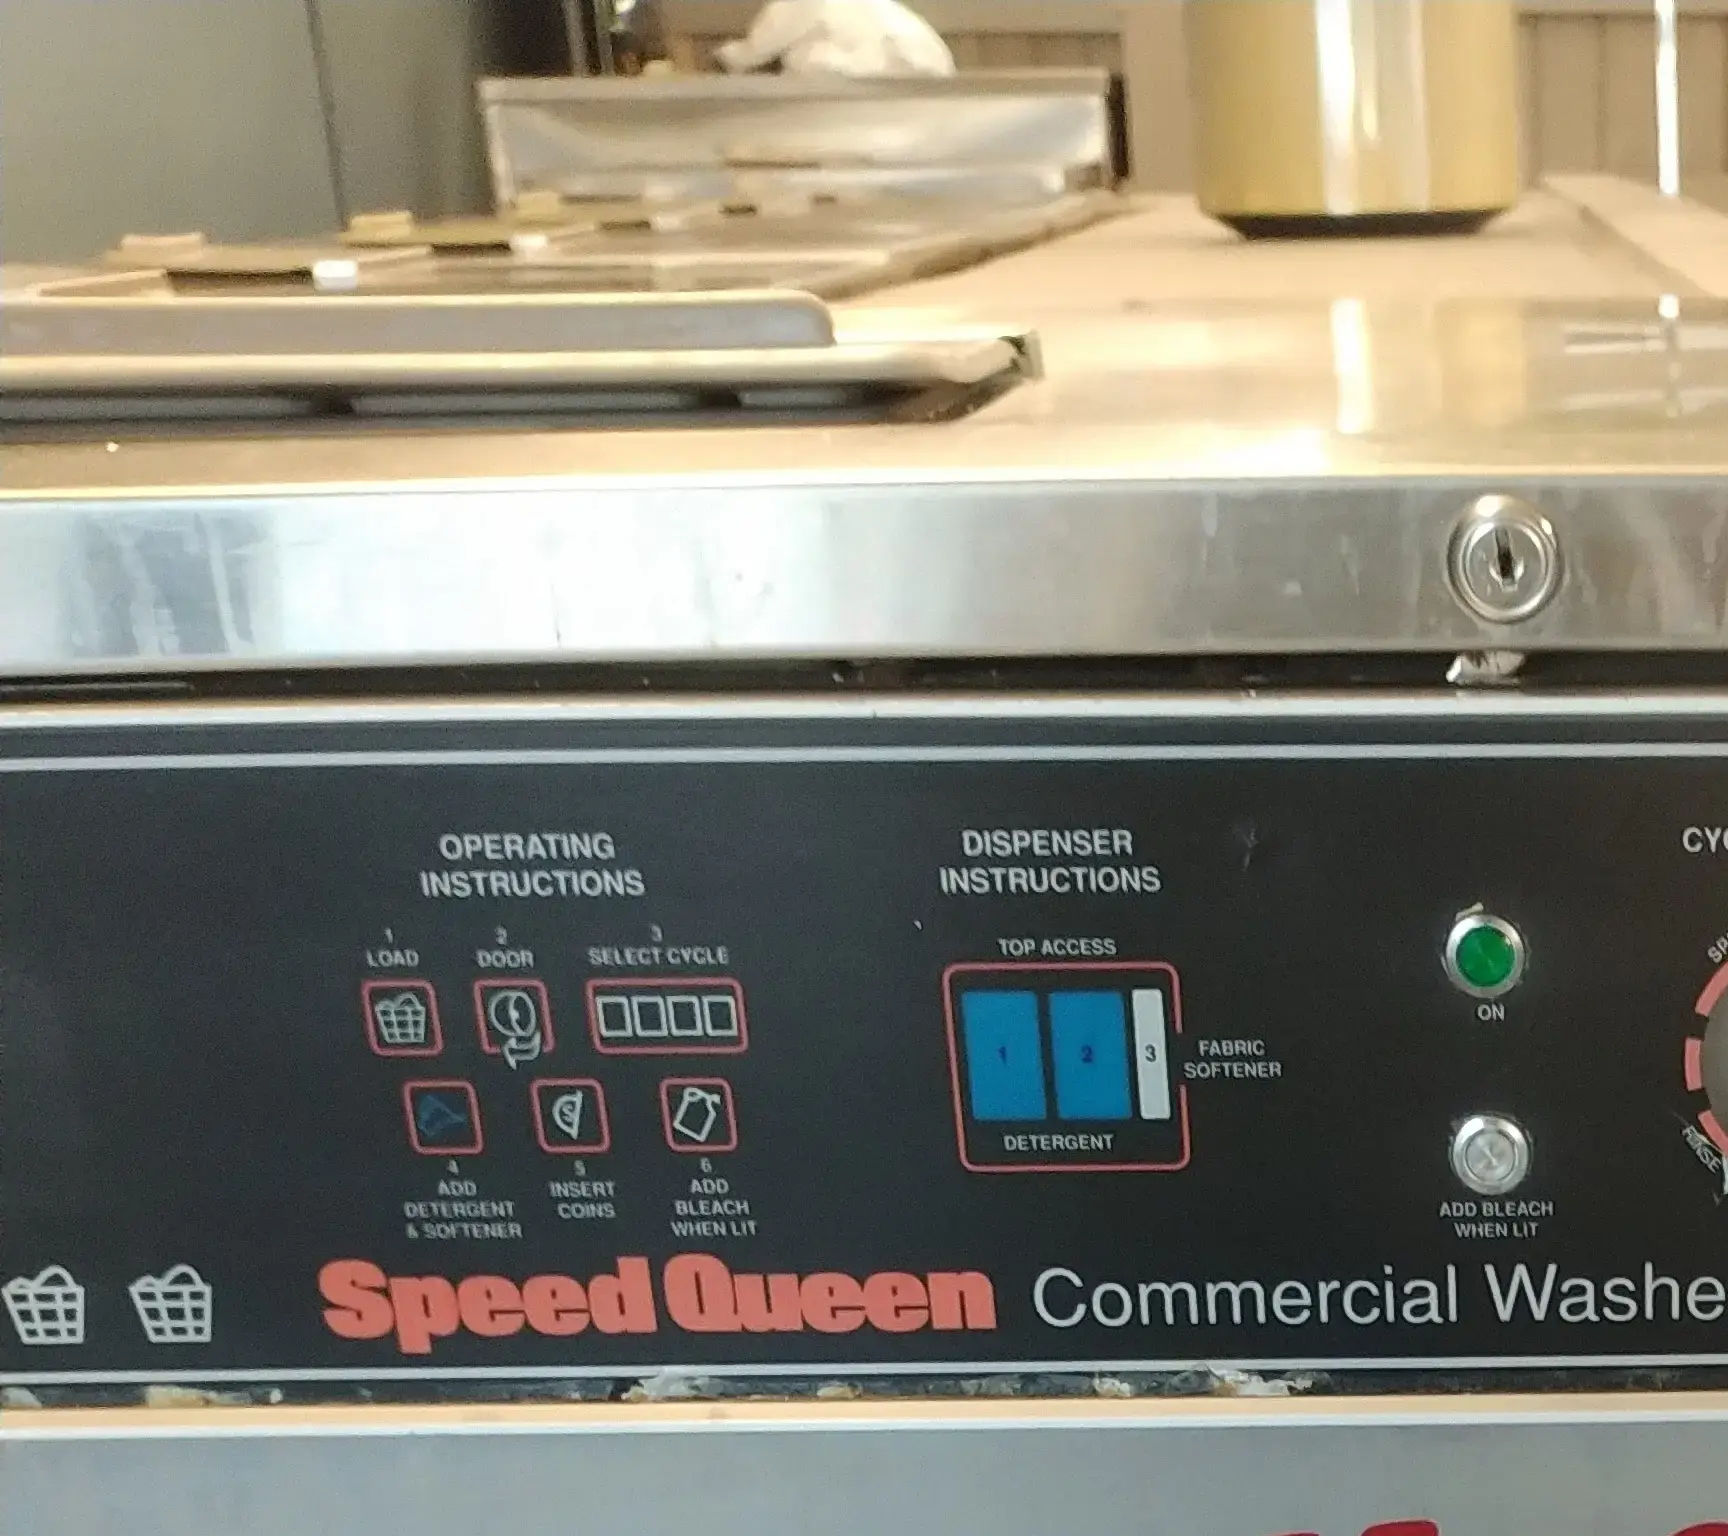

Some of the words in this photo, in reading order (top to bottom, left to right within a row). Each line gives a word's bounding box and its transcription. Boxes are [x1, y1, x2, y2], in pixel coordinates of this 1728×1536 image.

[439, 832, 616, 860] OPERATING
[962, 828, 1133, 857] DISPENSER
[420, 869, 646, 897] INSTRUCTIONS
[939, 866, 1162, 895] INSTRUCTIONS
[385, 927, 394, 943] 1
[587, 947, 662, 966] SELECT
[667, 946, 729, 965] CYCLE
[999, 938, 1036, 957] TOP
[1041, 938, 1117, 956] ACCESS
[366, 950, 419, 967] LOAD
[476, 950, 534, 968] DOOR
[1477, 1005, 1505, 1021] ON
[999, 1046, 1007, 1064] 1
[1081, 1046, 1093, 1064] 2
[1145, 1045, 1156, 1063] 3
[1199, 1040, 1265, 1057] FABRIC
[1184, 1062, 1282, 1079] SOFTENER
[1004, 1134, 1114, 1152] DETERGENT
[437, 1181, 476, 1196] ADD
[549, 1181, 615, 1199] INSERT
[691, 1179, 729, 1194] ADD
[404, 1201, 515, 1219] DETERGENT
[556, 1203, 616, 1219] COINS
[675, 1200, 750, 1216] BLEACH
[1439, 1202, 1477, 1217] ADD
[1483, 1201, 1554, 1217] BLEACH
[422, 1223, 523, 1241] SOFTENER
[671, 1222, 727, 1238] WHEN
[731, 1221, 758, 1237] LIT
[1454, 1222, 1508, 1239] WHEN
[1512, 1222, 1539, 1238] LIT
[317, 1255, 658, 1355] Speed
[662, 1253, 997, 1335] Queen
[1031, 1262, 1461, 1331] Commercial
